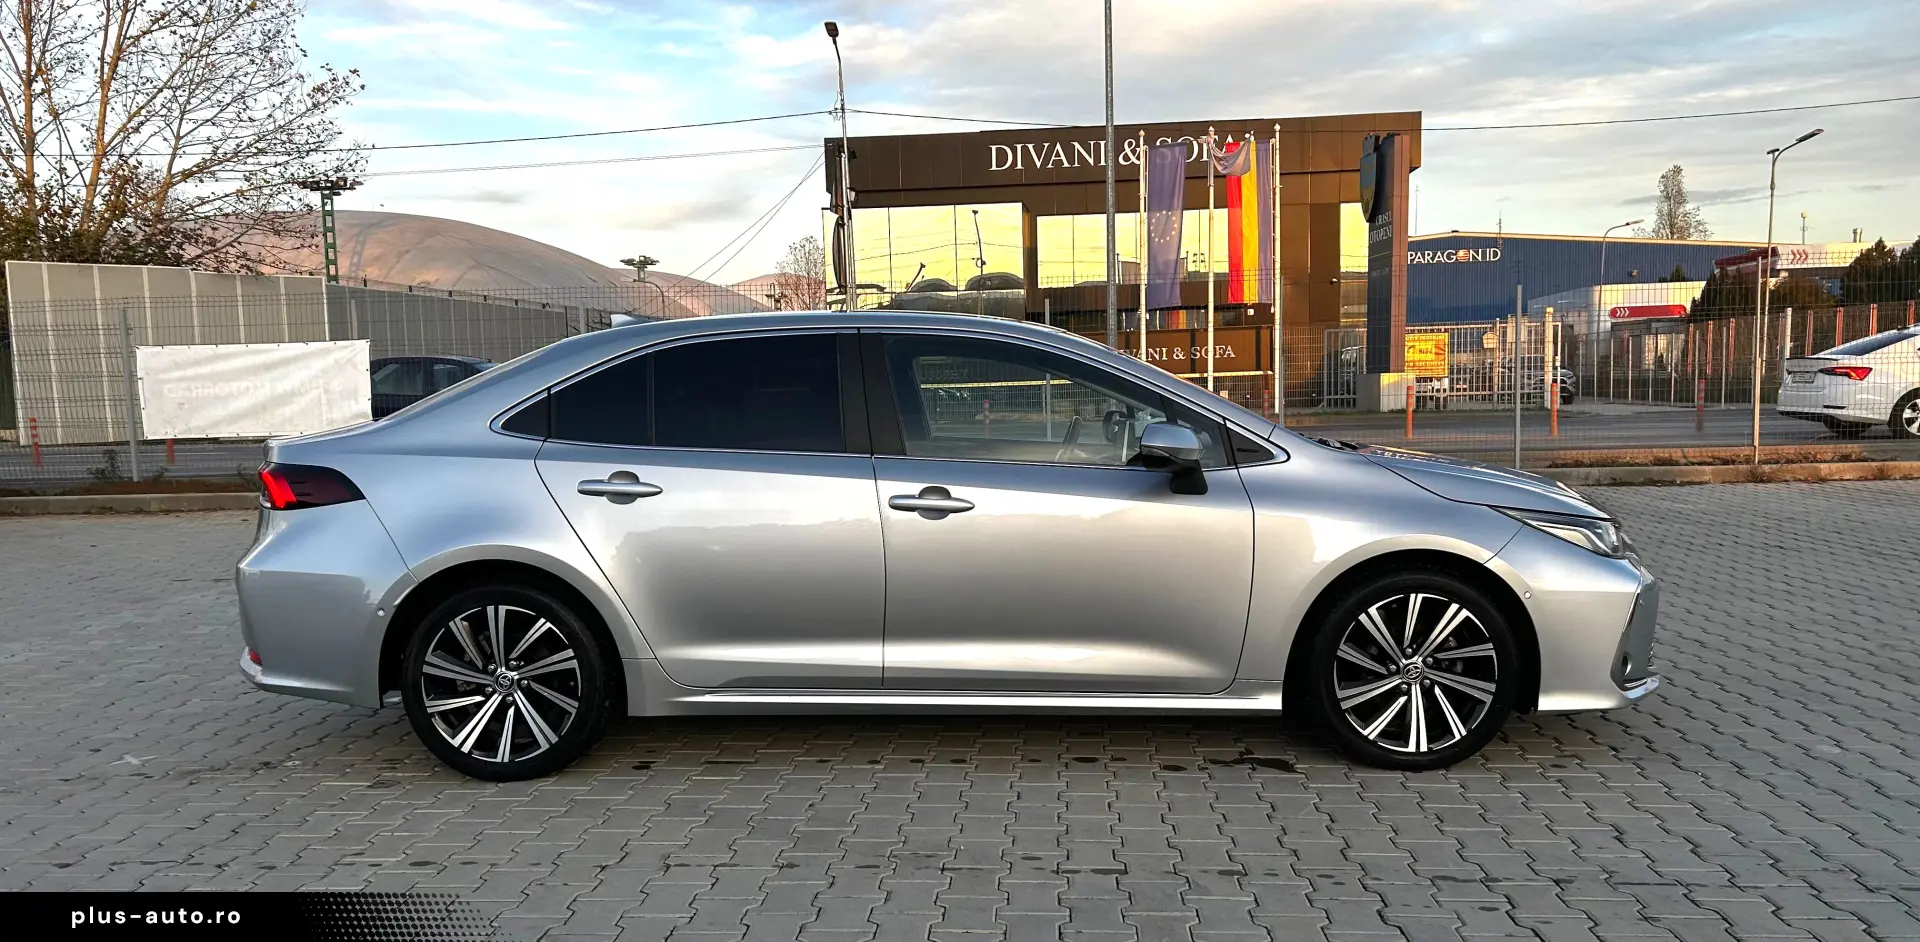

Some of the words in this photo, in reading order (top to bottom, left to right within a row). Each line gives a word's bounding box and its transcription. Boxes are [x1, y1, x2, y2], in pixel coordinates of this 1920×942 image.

[988, 140, 1107, 171] DIVANI
[1118, 138, 1142, 166] &
[1408, 249, 1482, 264] PARAGON
[1486, 248, 1501, 262] ID
[1173, 347, 1186, 360] &
